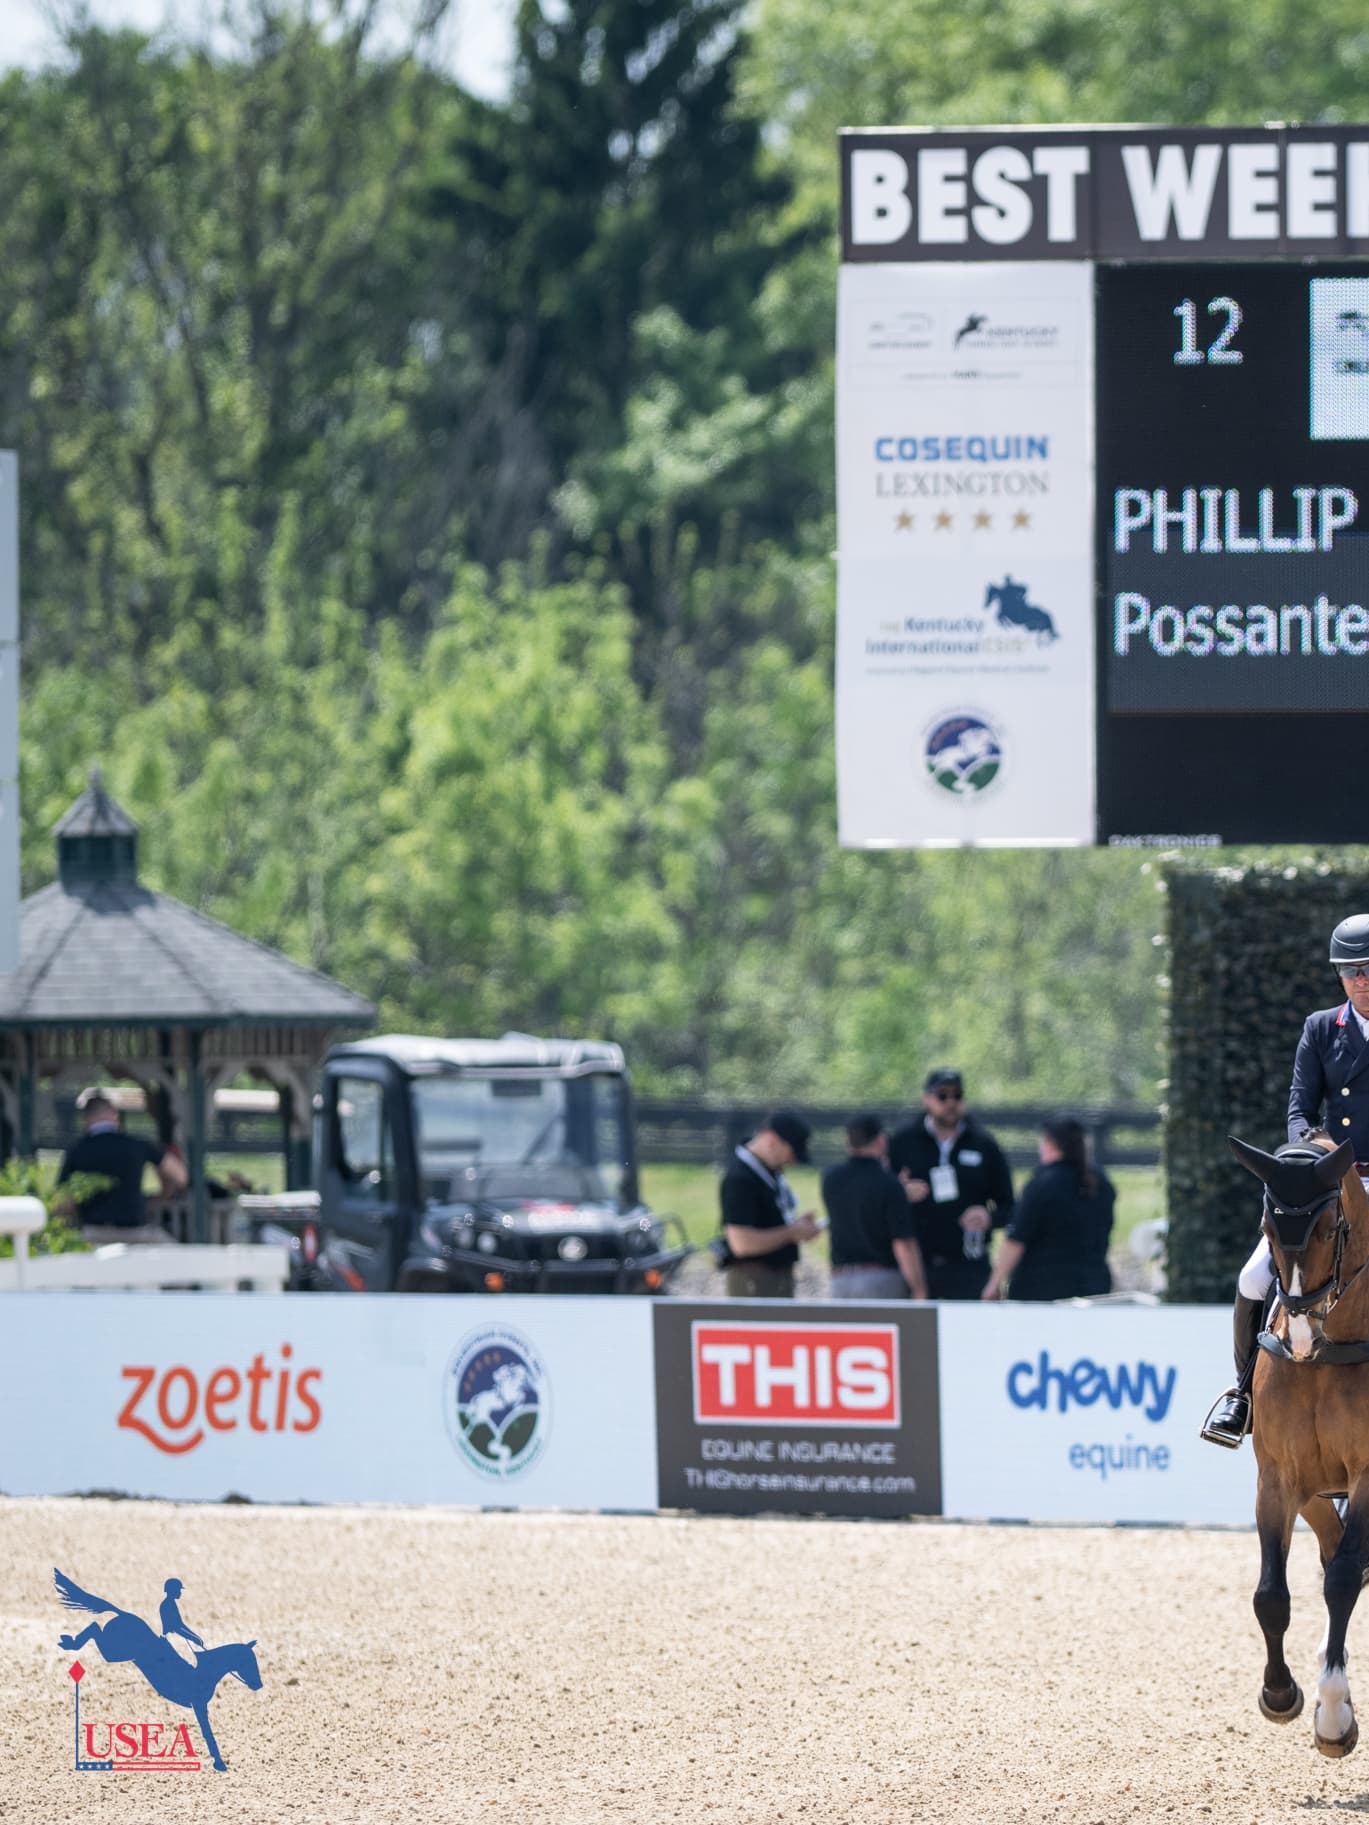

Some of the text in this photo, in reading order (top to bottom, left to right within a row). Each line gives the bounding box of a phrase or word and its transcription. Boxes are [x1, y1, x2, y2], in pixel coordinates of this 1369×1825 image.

[851, 147, 1090, 244] BEST
[1173, 297, 1244, 365] 12
[875, 436, 1049, 463] COSEQUIN
[875, 472, 1049, 497] LEXINGTON
[1114, 487, 1359, 554] PHILLIP
[865, 638, 981, 655] International
[904, 616, 985, 634] Kentucky
[117, 1343, 322, 1456] zoetis
[700, 1343, 895, 1411] THIS
[1006, 1350, 1178, 1422] chewy
[701, 1438, 896, 1465] EQUINE INSURANCE
[1068, 1434, 1172, 1480] equine
